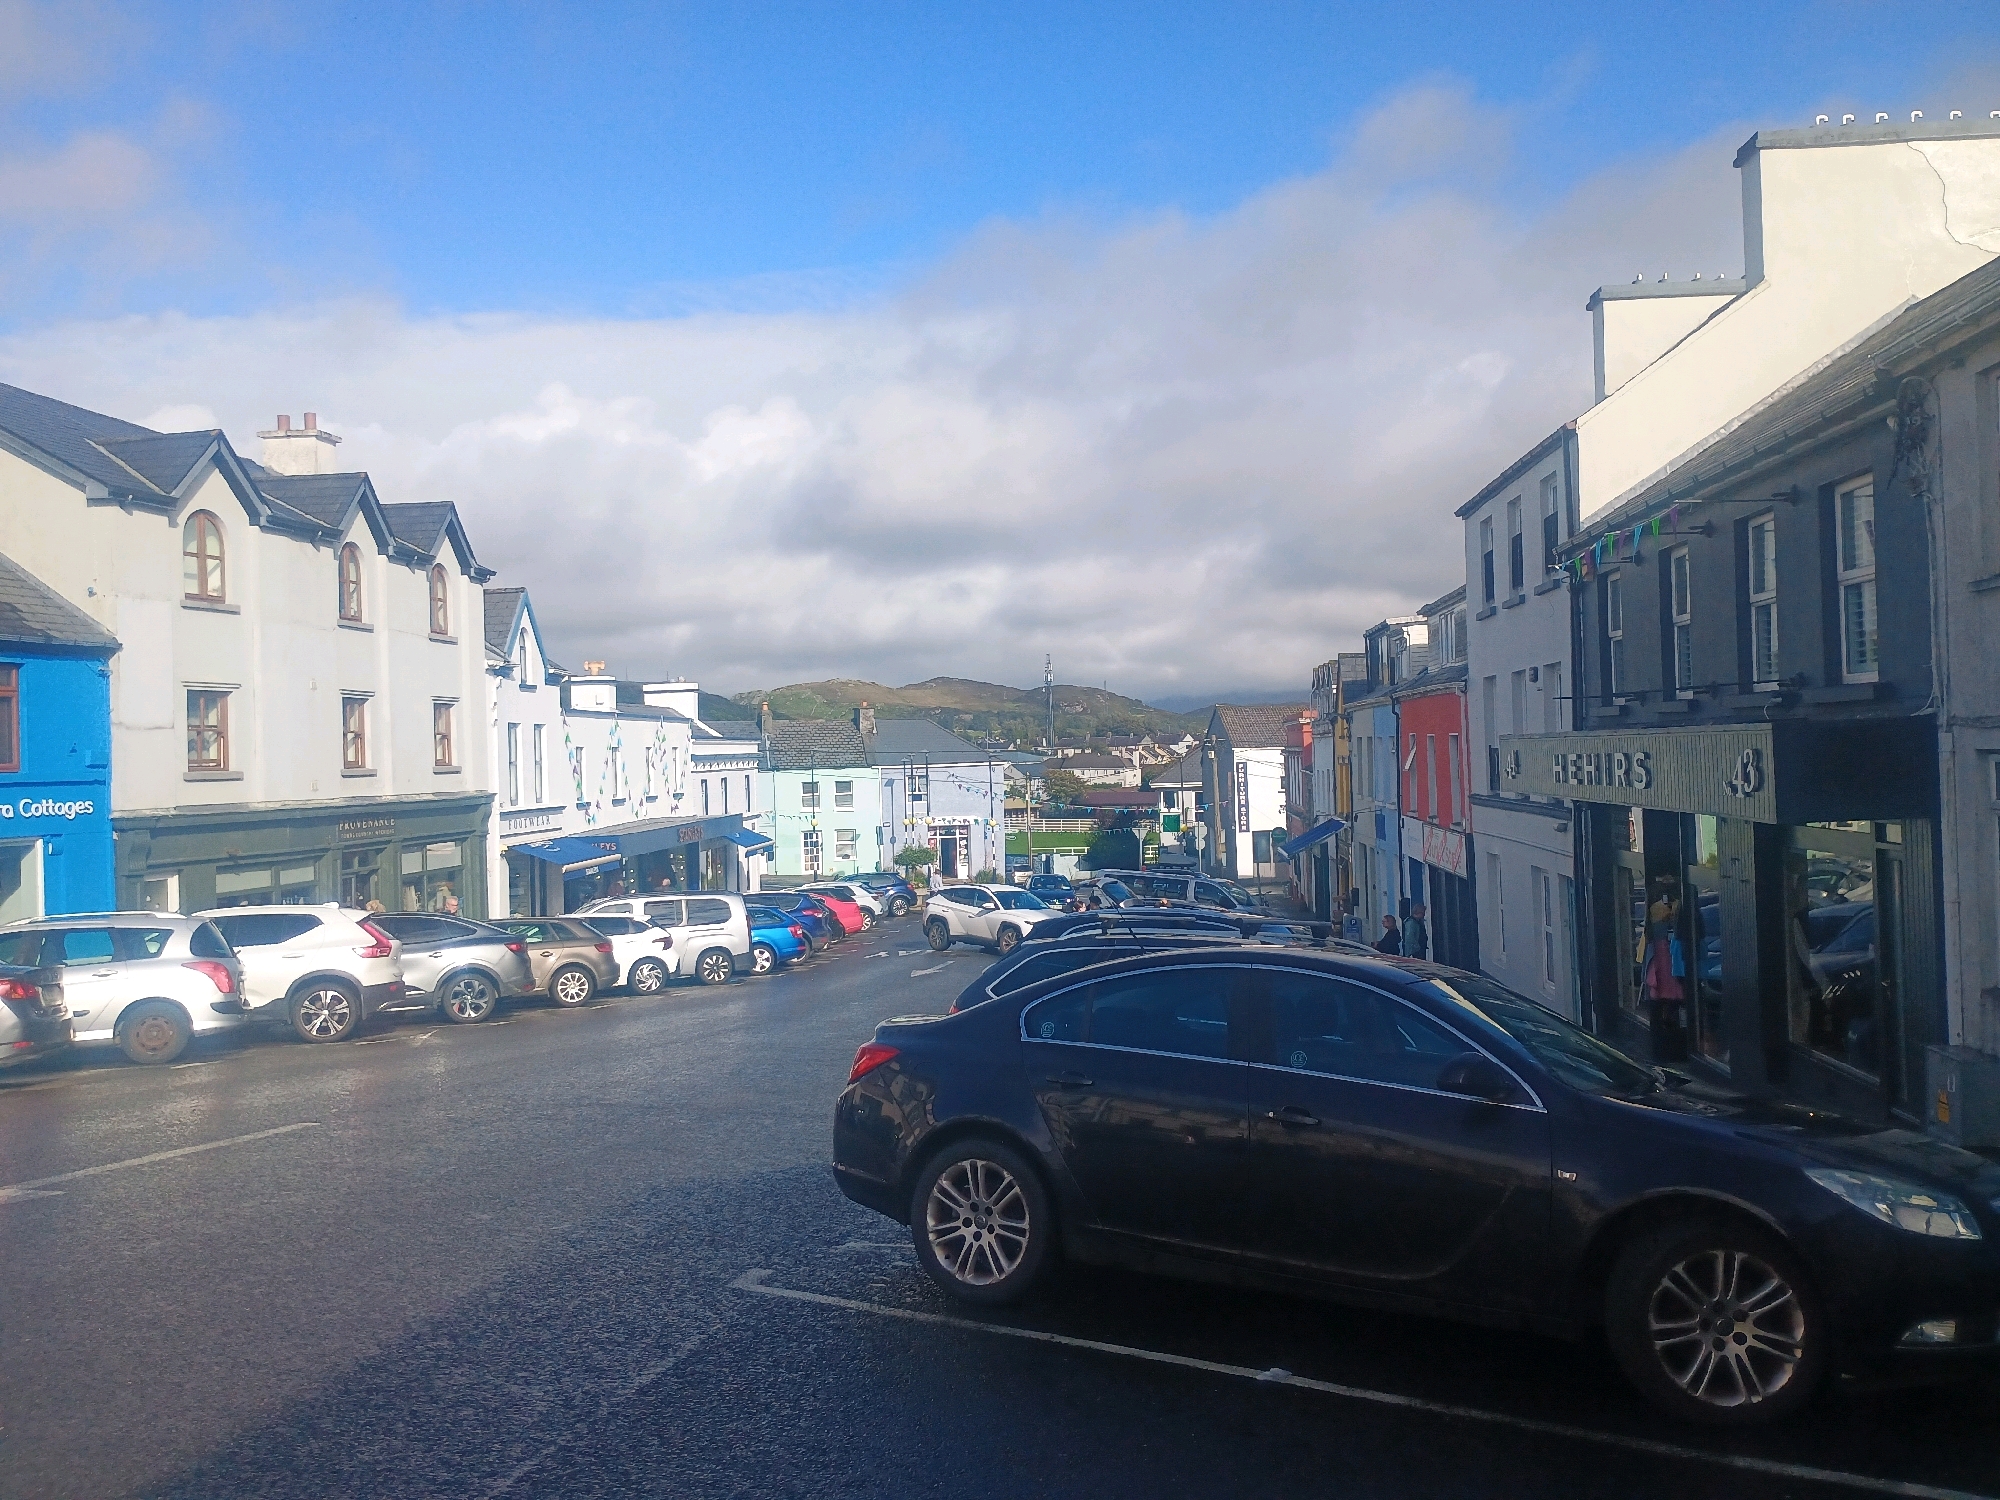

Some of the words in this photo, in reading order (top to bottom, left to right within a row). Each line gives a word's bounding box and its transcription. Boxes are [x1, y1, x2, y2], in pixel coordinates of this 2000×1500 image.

[1238, 763, 1246, 805] FURNITURE
[1552, 751, 1647, 790] HEHIRS
[19, 798, 94, 820] Cottages
[508, 815, 551, 831] FOOTWEAR
